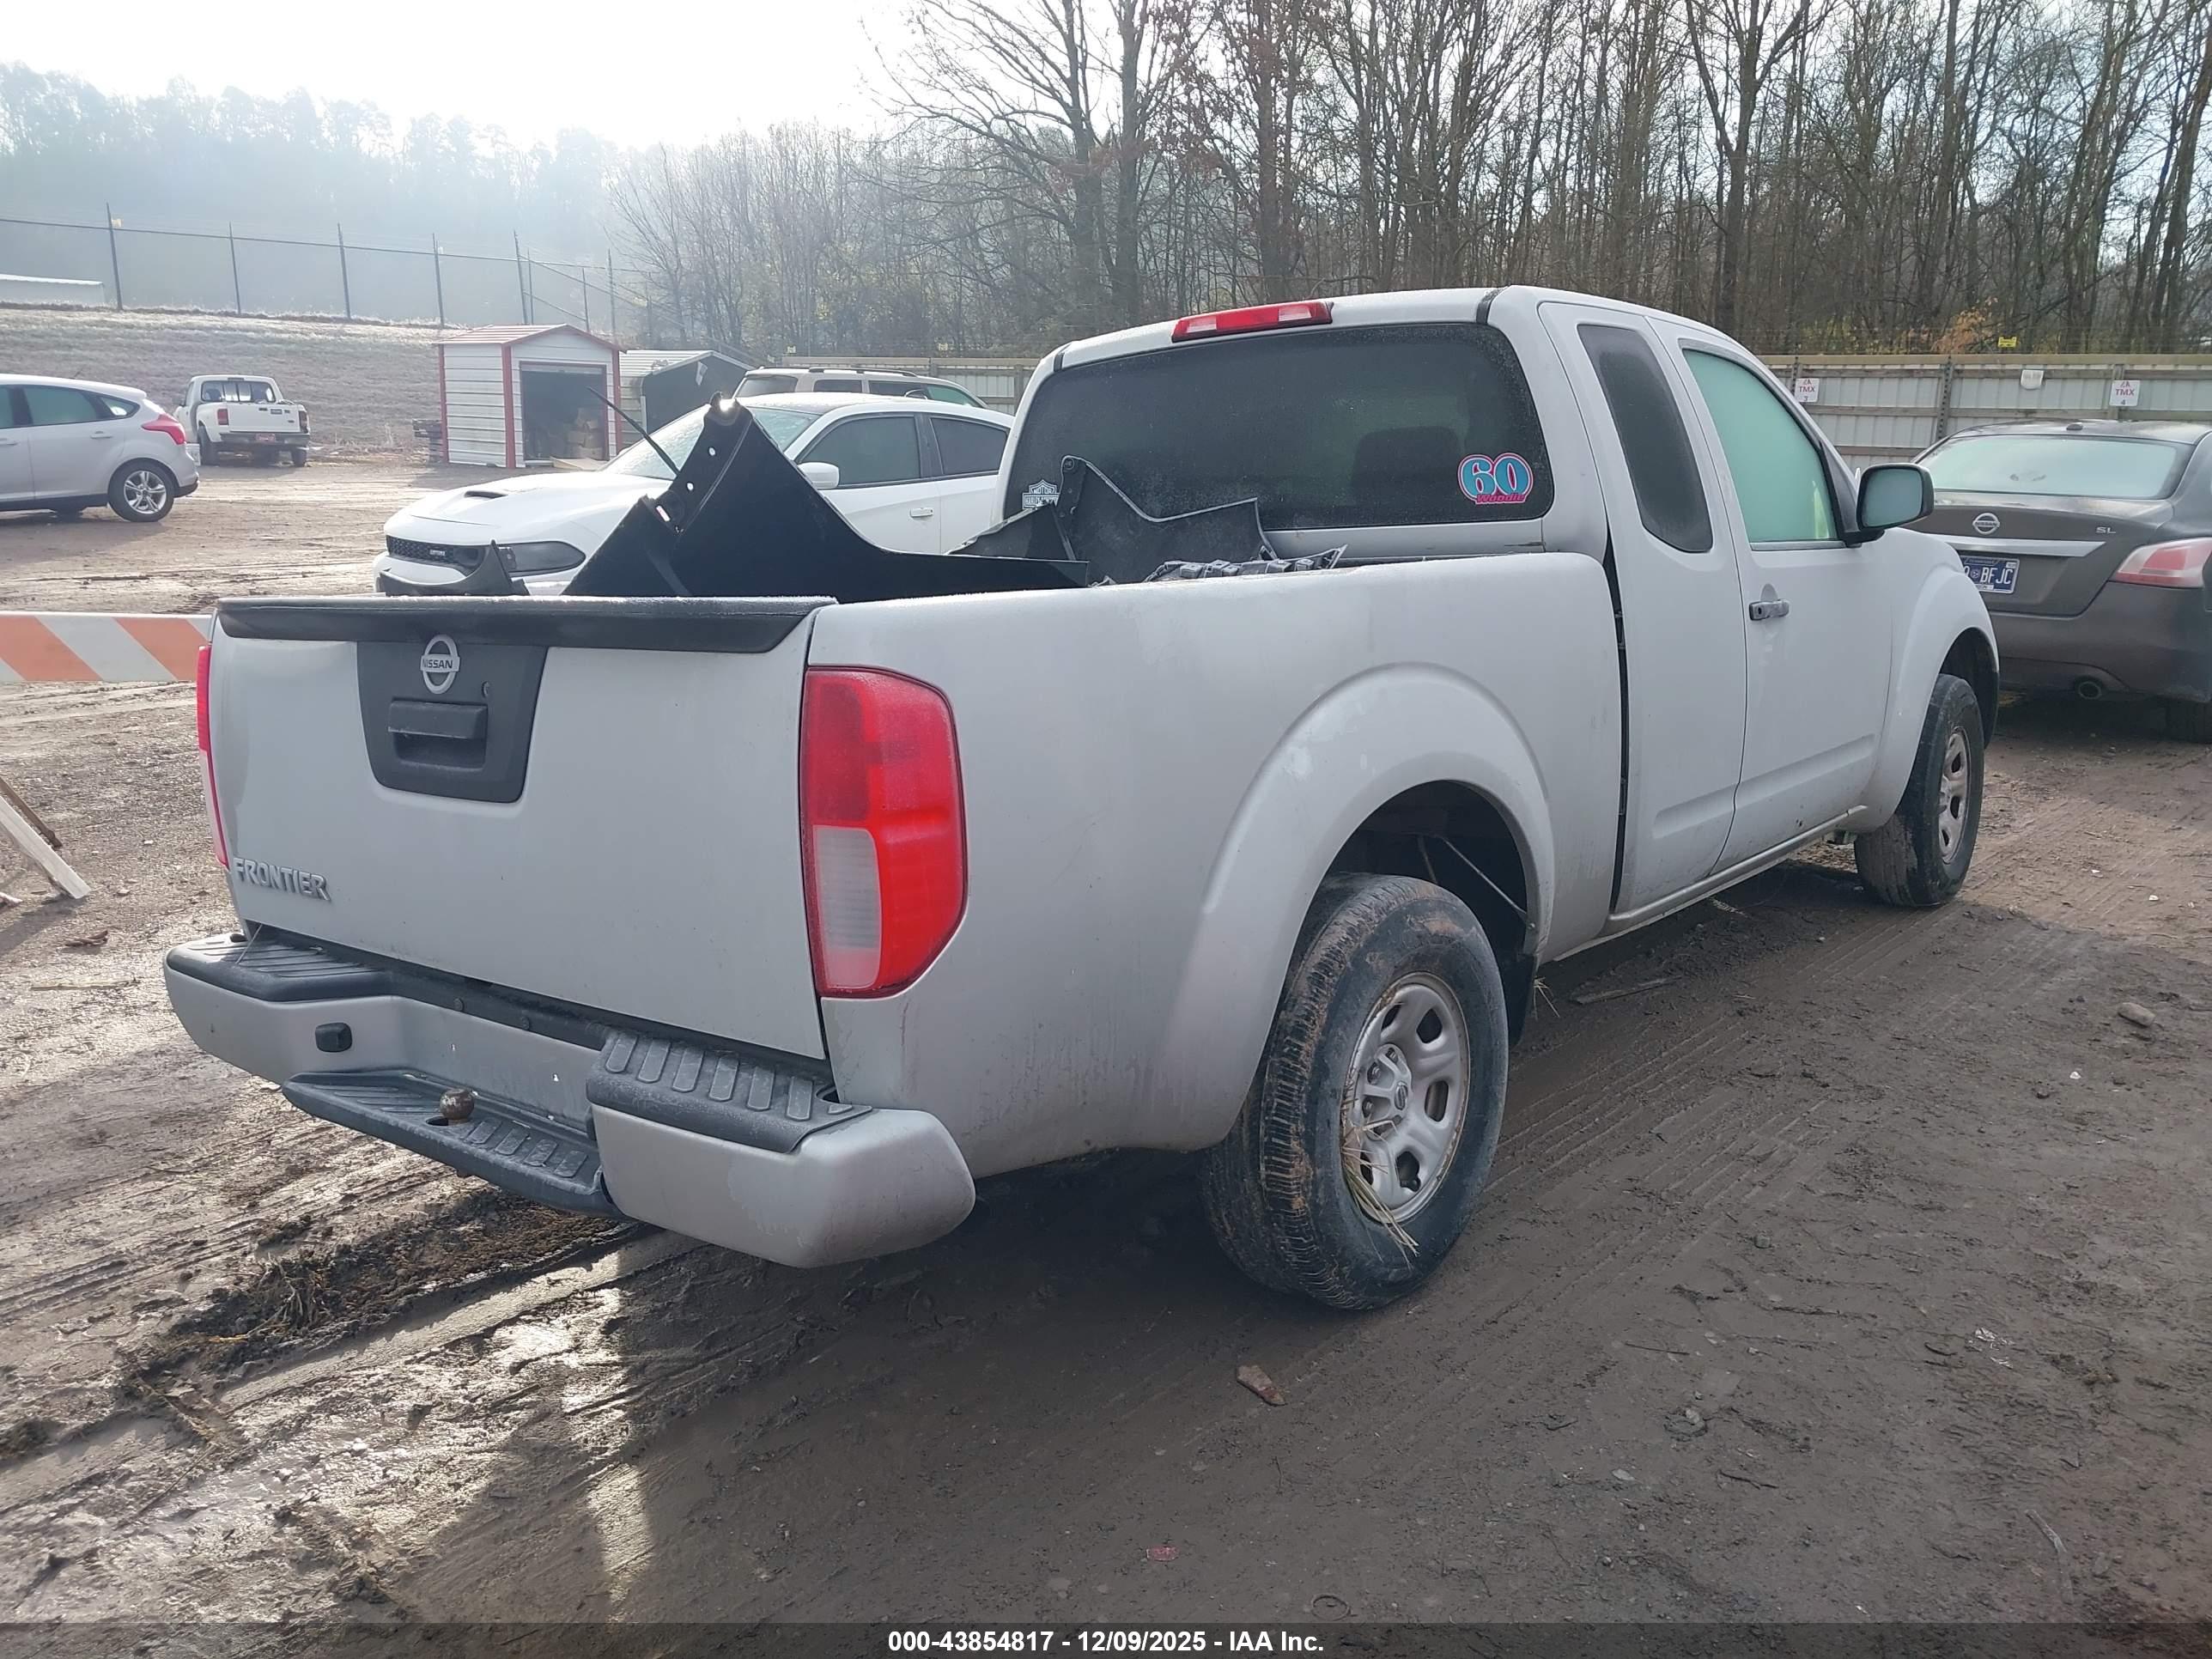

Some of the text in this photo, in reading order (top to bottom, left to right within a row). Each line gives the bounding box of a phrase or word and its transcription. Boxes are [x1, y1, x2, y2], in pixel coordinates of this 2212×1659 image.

[1461, 456, 1530, 499] 60
[1980, 567, 2014, 585] BFJC
[422, 659, 453, 669] NISSAN
[233, 858, 331, 902] FRONTIER
